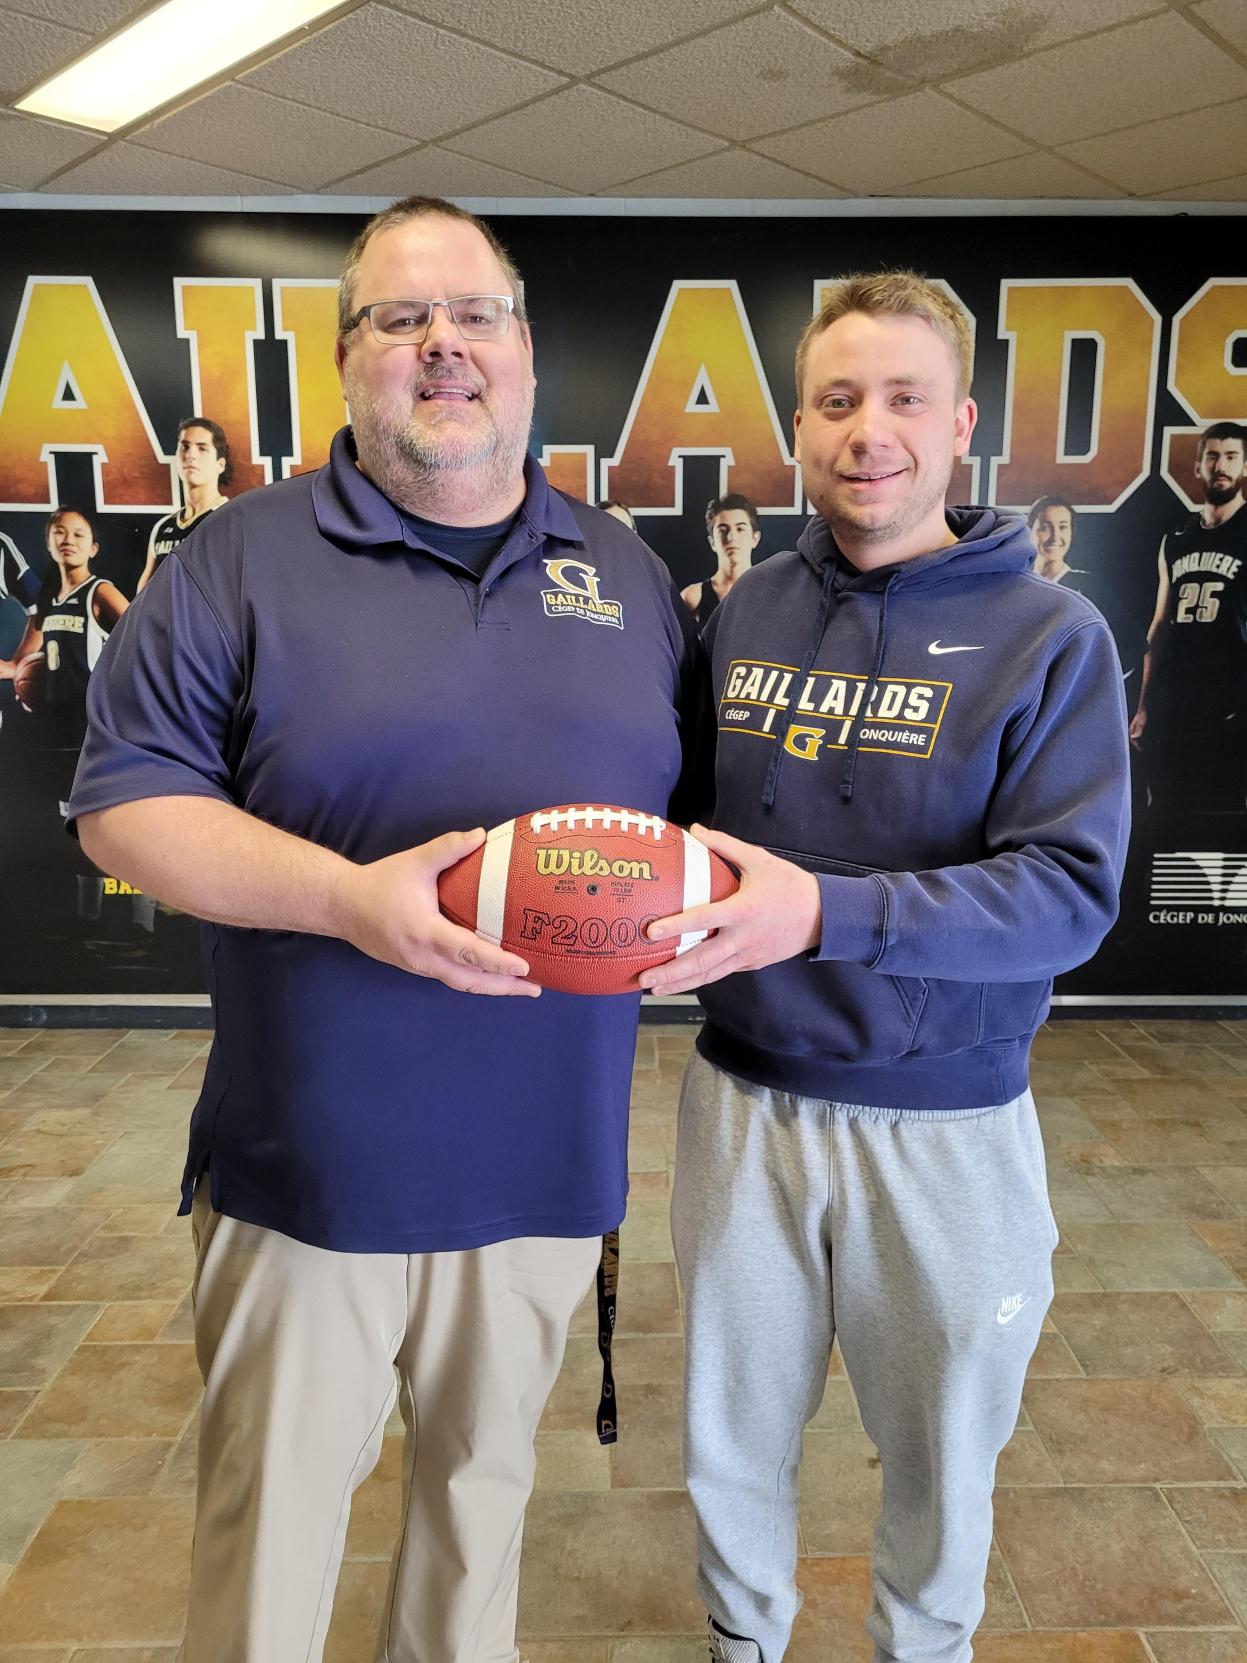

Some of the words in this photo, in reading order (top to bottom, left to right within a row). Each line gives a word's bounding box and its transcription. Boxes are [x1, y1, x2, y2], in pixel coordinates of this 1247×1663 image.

[545, 593, 620, 618] GAILLARDS
[1176, 582, 1225, 623] 25
[726, 666, 934, 721] GAILLARDS
[725, 707, 751, 721] CÉGEP
[859, 728, 927, 746] ONQUIÈRE
[783, 724, 827, 761] G
[535, 847, 652, 881] Wilson
[1148, 909, 1195, 924] CÉGEP
[1197, 912, 1216, 924] DE
[1001, 1292, 1023, 1313] NIKE
